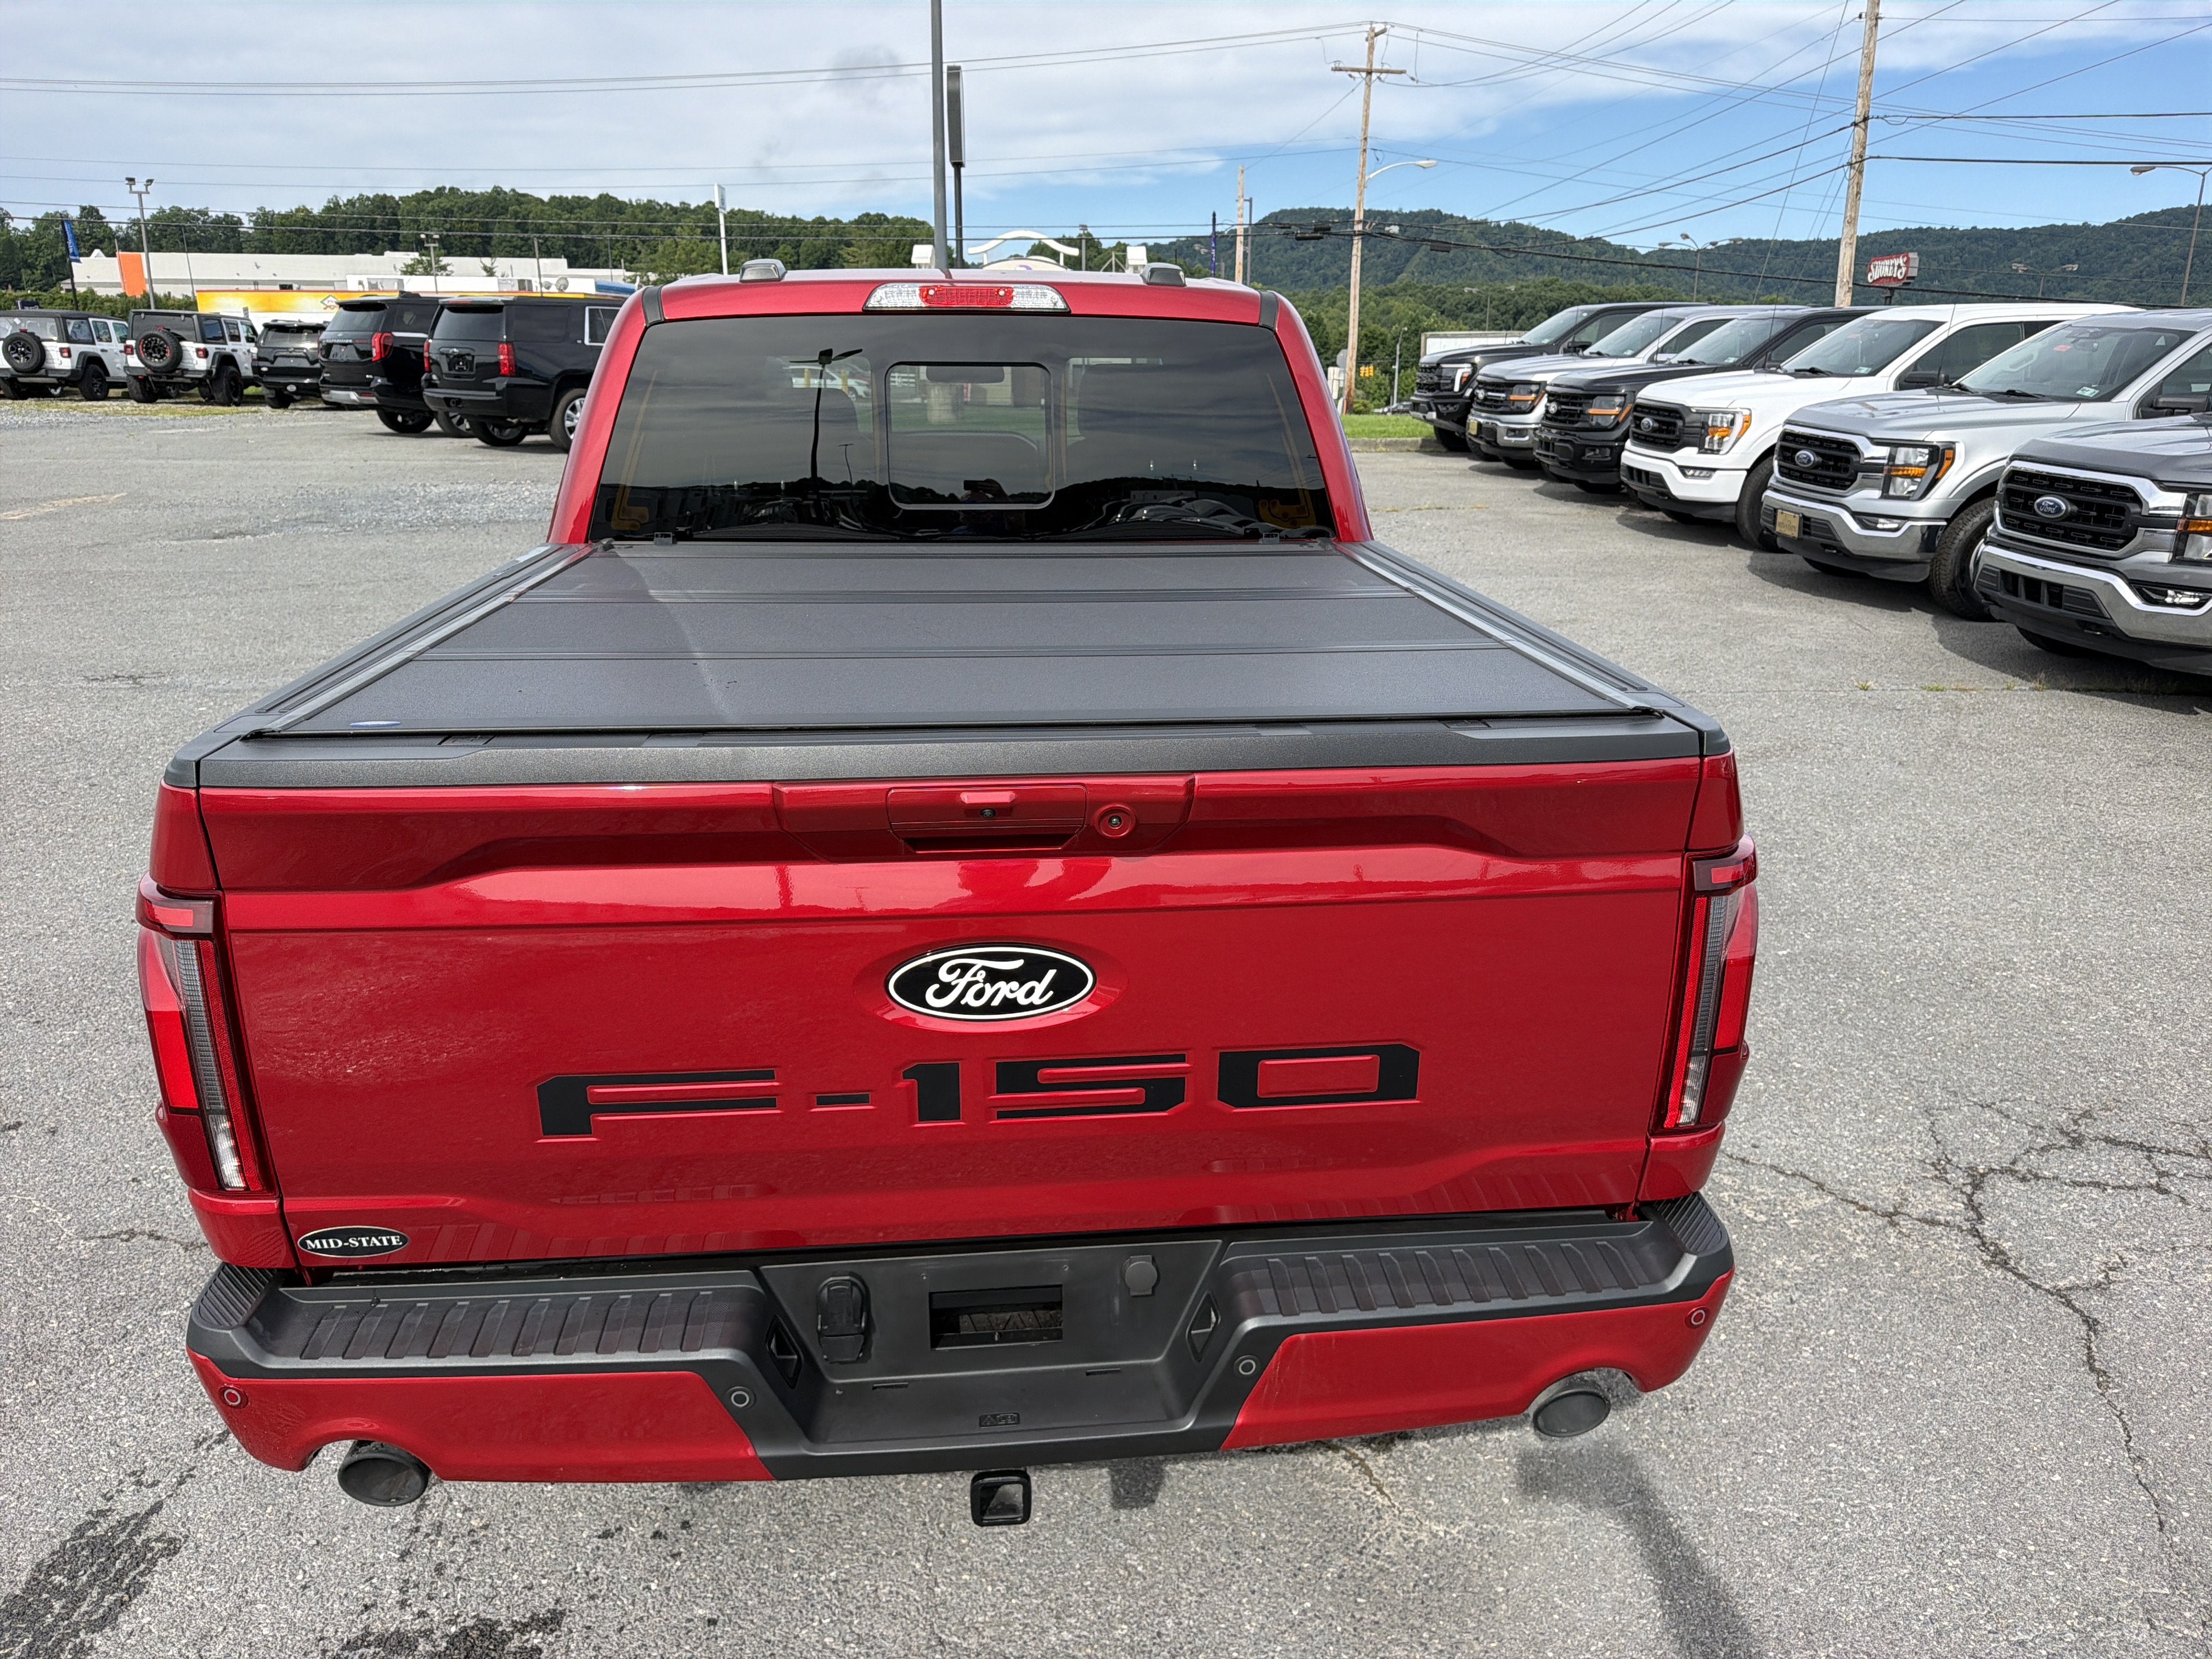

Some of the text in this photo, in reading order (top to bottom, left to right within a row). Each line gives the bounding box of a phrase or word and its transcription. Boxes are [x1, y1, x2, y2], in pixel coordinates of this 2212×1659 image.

[925, 958, 1057, 1007] Ford
[537, 1042, 1421, 1136] F-150
[305, 1235, 403, 1250] MID-STATE
